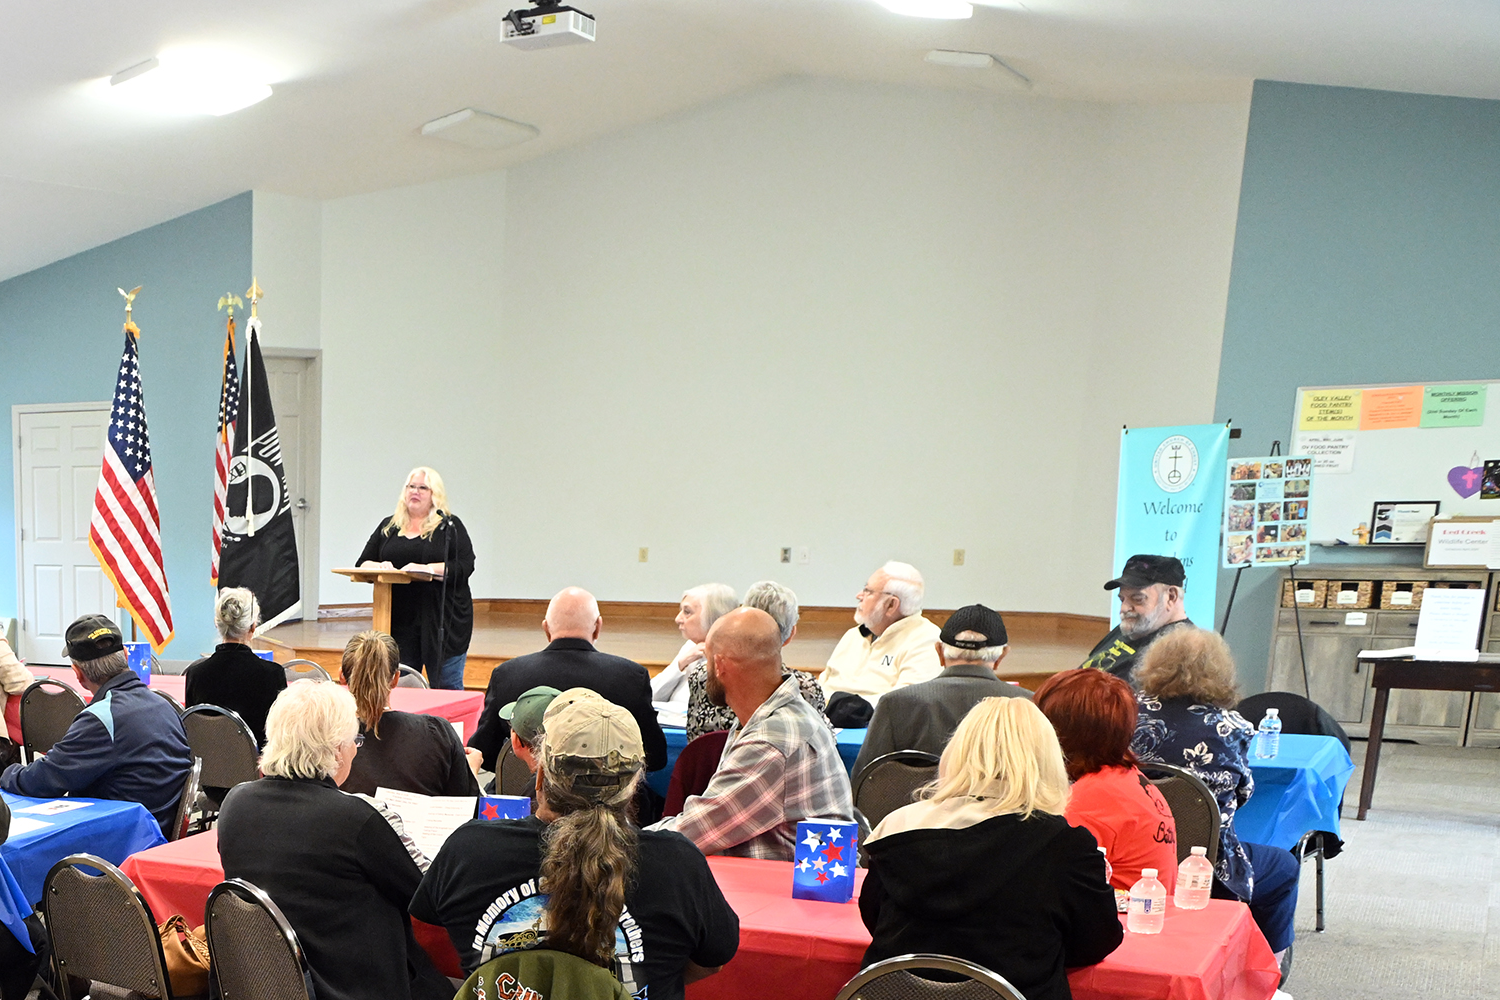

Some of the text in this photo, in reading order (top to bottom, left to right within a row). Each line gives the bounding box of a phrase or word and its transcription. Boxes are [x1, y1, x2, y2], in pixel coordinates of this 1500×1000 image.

[1143, 497, 1204, 515] Welcome
[1164, 529, 1178, 542] to
[471, 878, 537, 951] In Memory of
